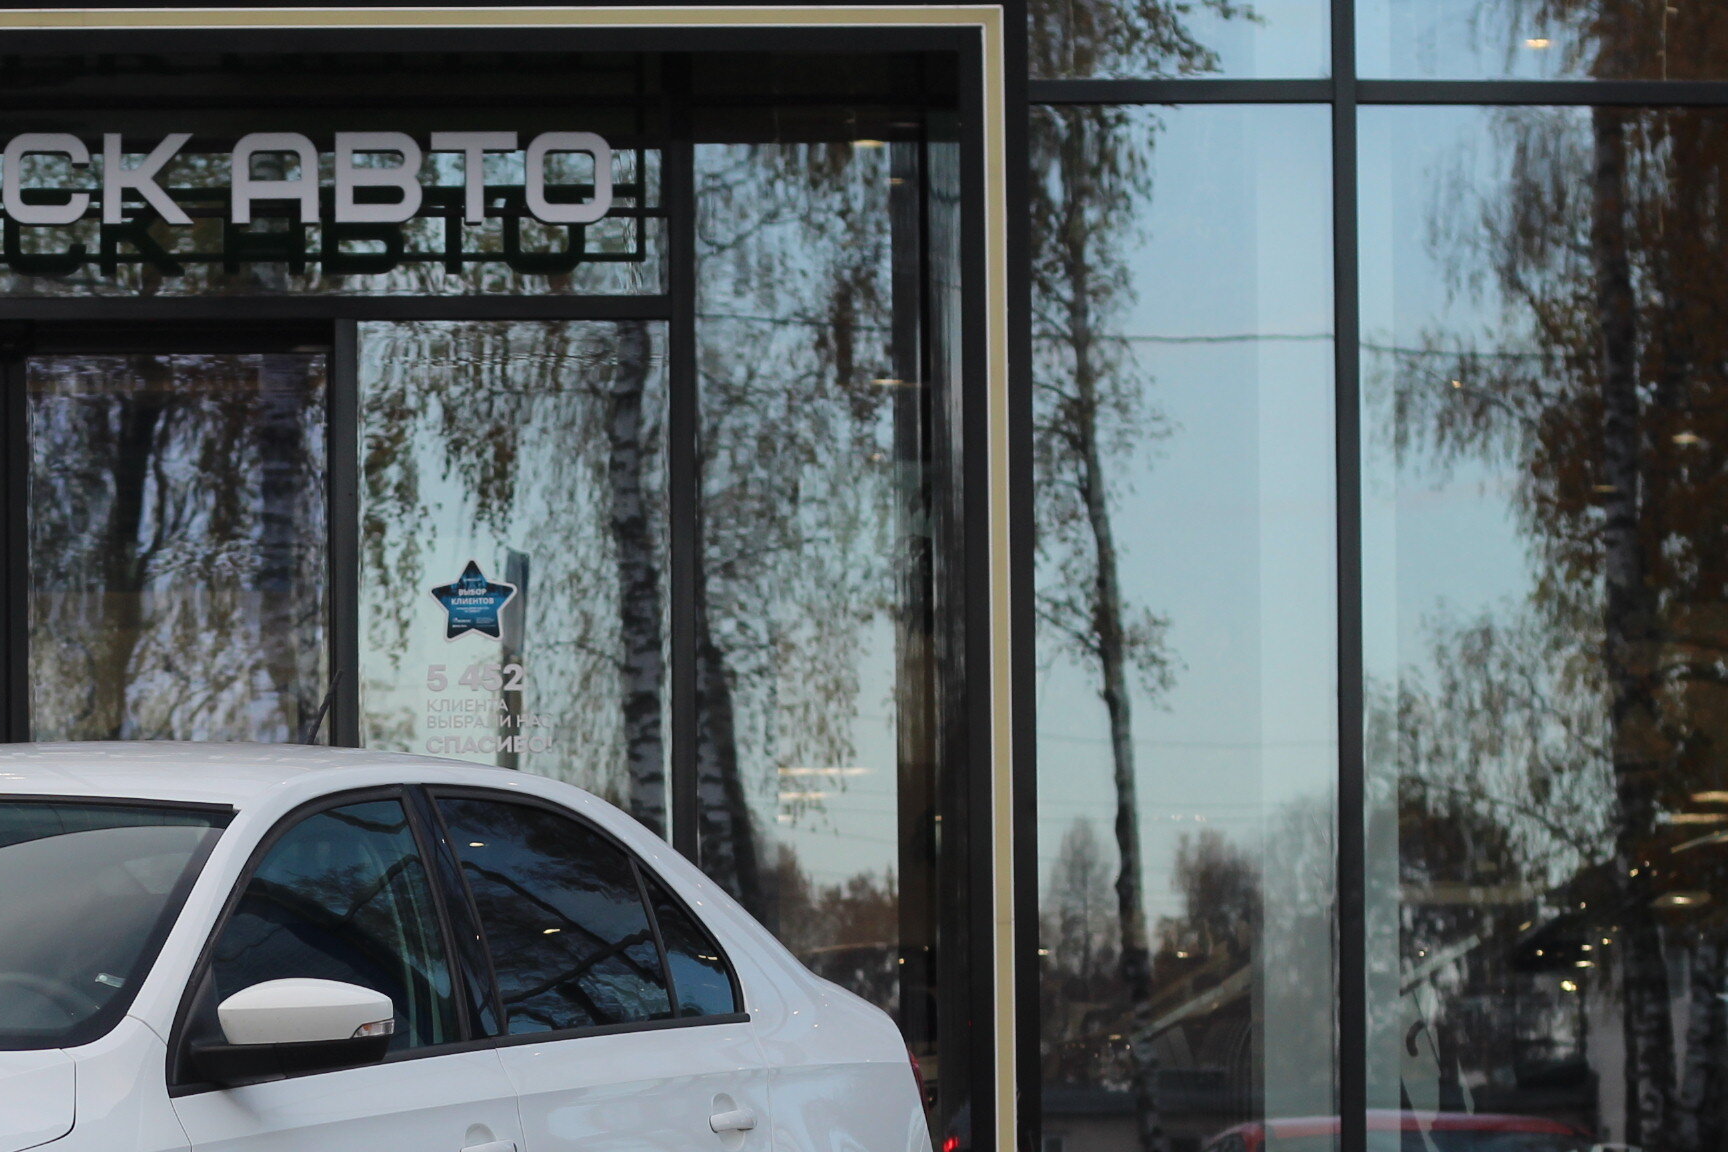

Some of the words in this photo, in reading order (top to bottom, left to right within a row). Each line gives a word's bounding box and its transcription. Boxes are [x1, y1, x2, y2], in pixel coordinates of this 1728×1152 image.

[231, 131, 613, 225] АВТО
[451, 597, 494, 606] КЛИЕНТОВ
[426, 664, 448, 692] 5
[458, 663, 524, 692] 452
[427, 699, 509, 712] КЛИЕНТА
